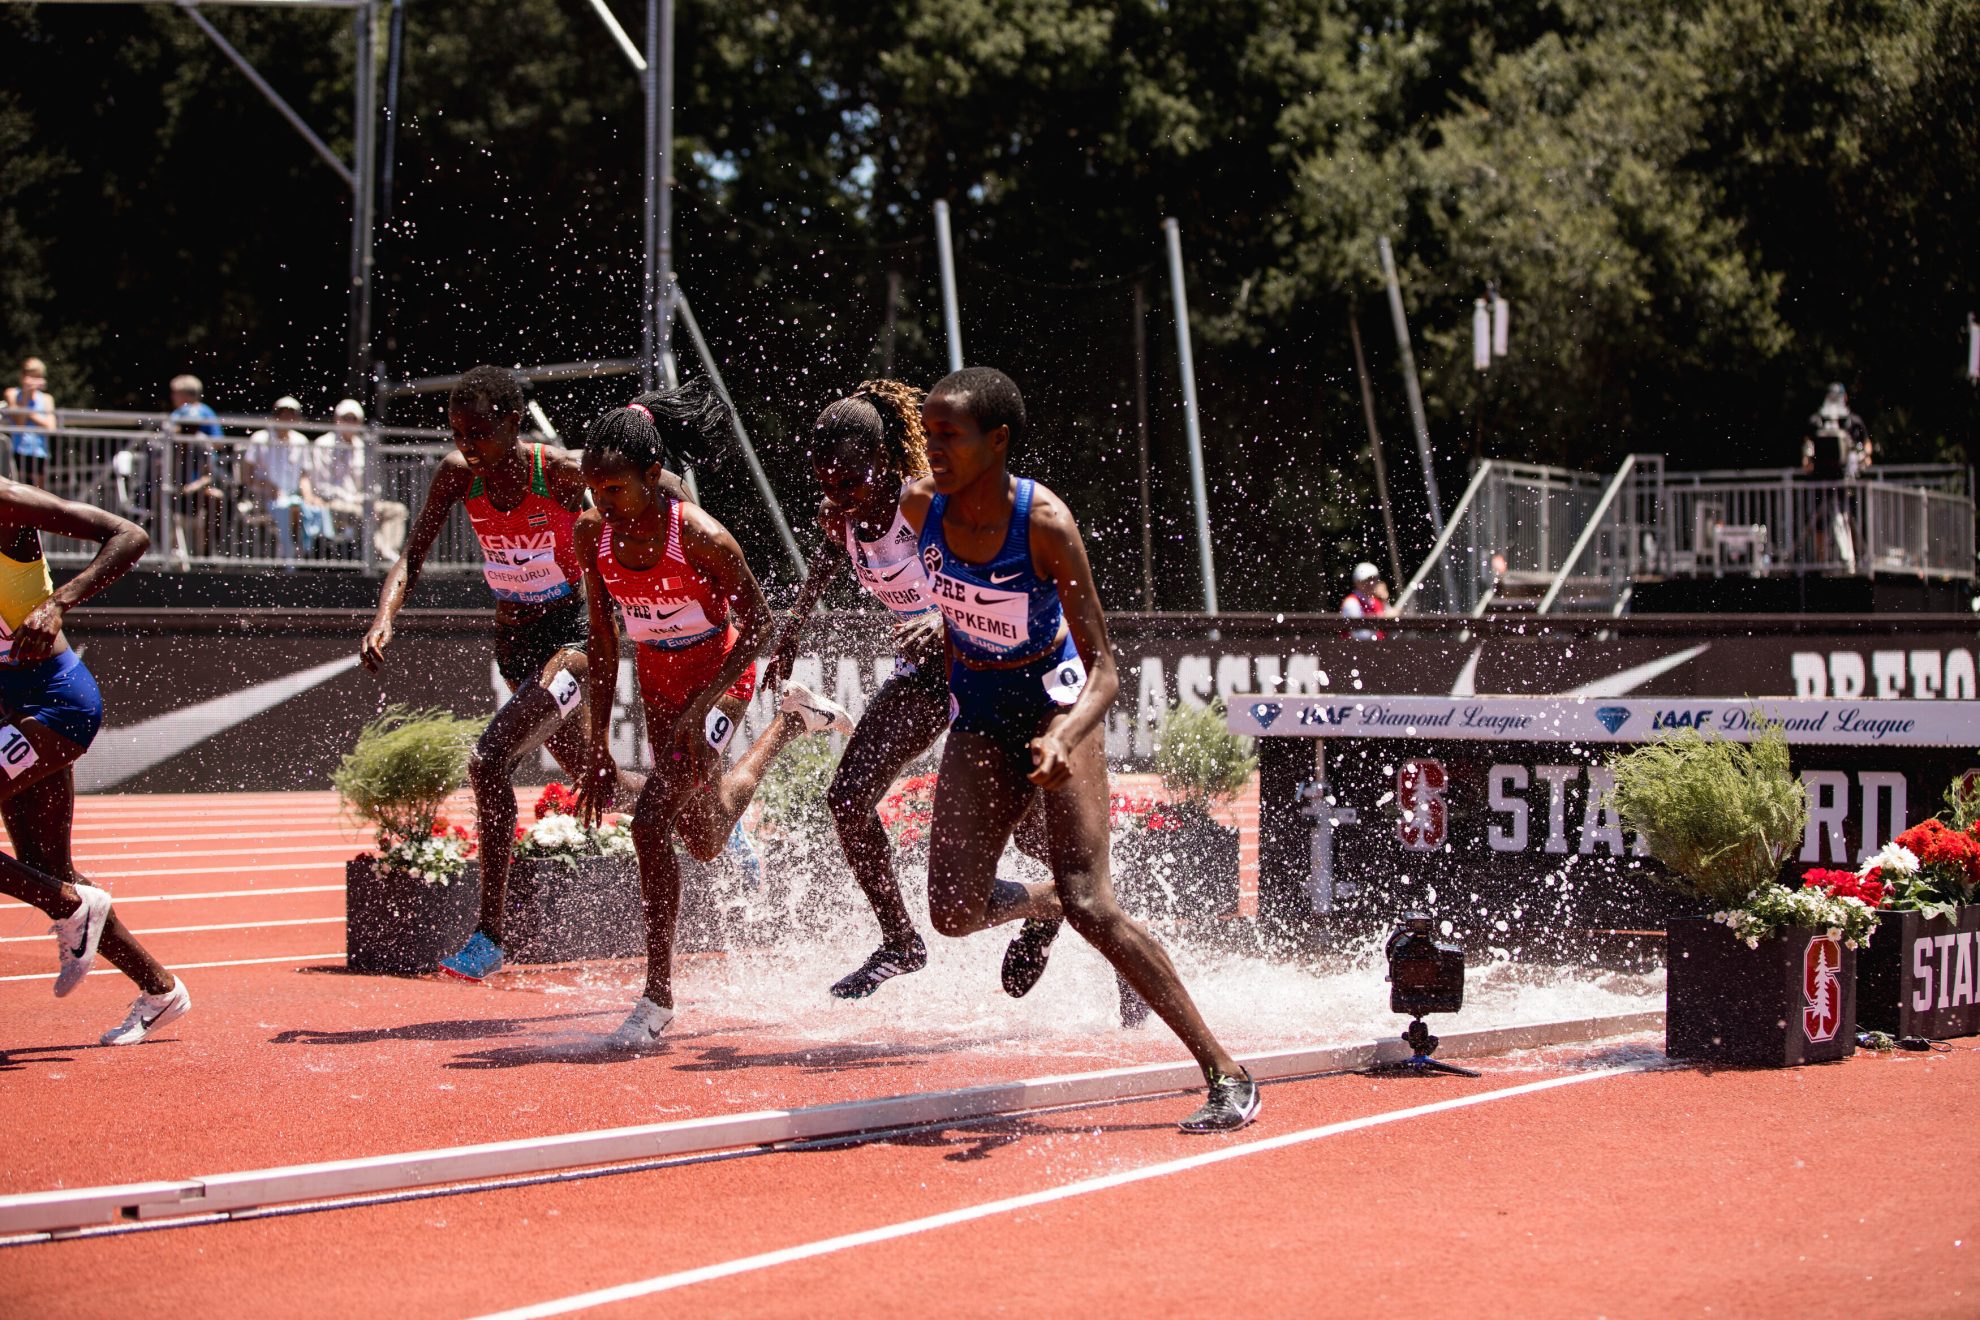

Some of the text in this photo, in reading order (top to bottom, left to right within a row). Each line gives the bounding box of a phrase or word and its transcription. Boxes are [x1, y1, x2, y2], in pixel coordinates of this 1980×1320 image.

[479, 529, 556, 549] KENYA
[894, 534, 919, 545] adida
[486, 550, 510, 566] PRE
[487, 567, 551, 583] CHEPKURUI
[520, 588, 562, 603] Eugene
[932, 574, 966, 603] PRE
[626, 605, 652, 620] PRE
[559, 681, 578, 705] 3
[711, 716, 730, 744] 9
[1360, 704, 1456, 727] Diamond
[1459, 705, 1533, 735] League
[1652, 709, 1713, 730] IAAF
[1832, 707, 1915, 739] League
[2, 732, 31, 765] 10
